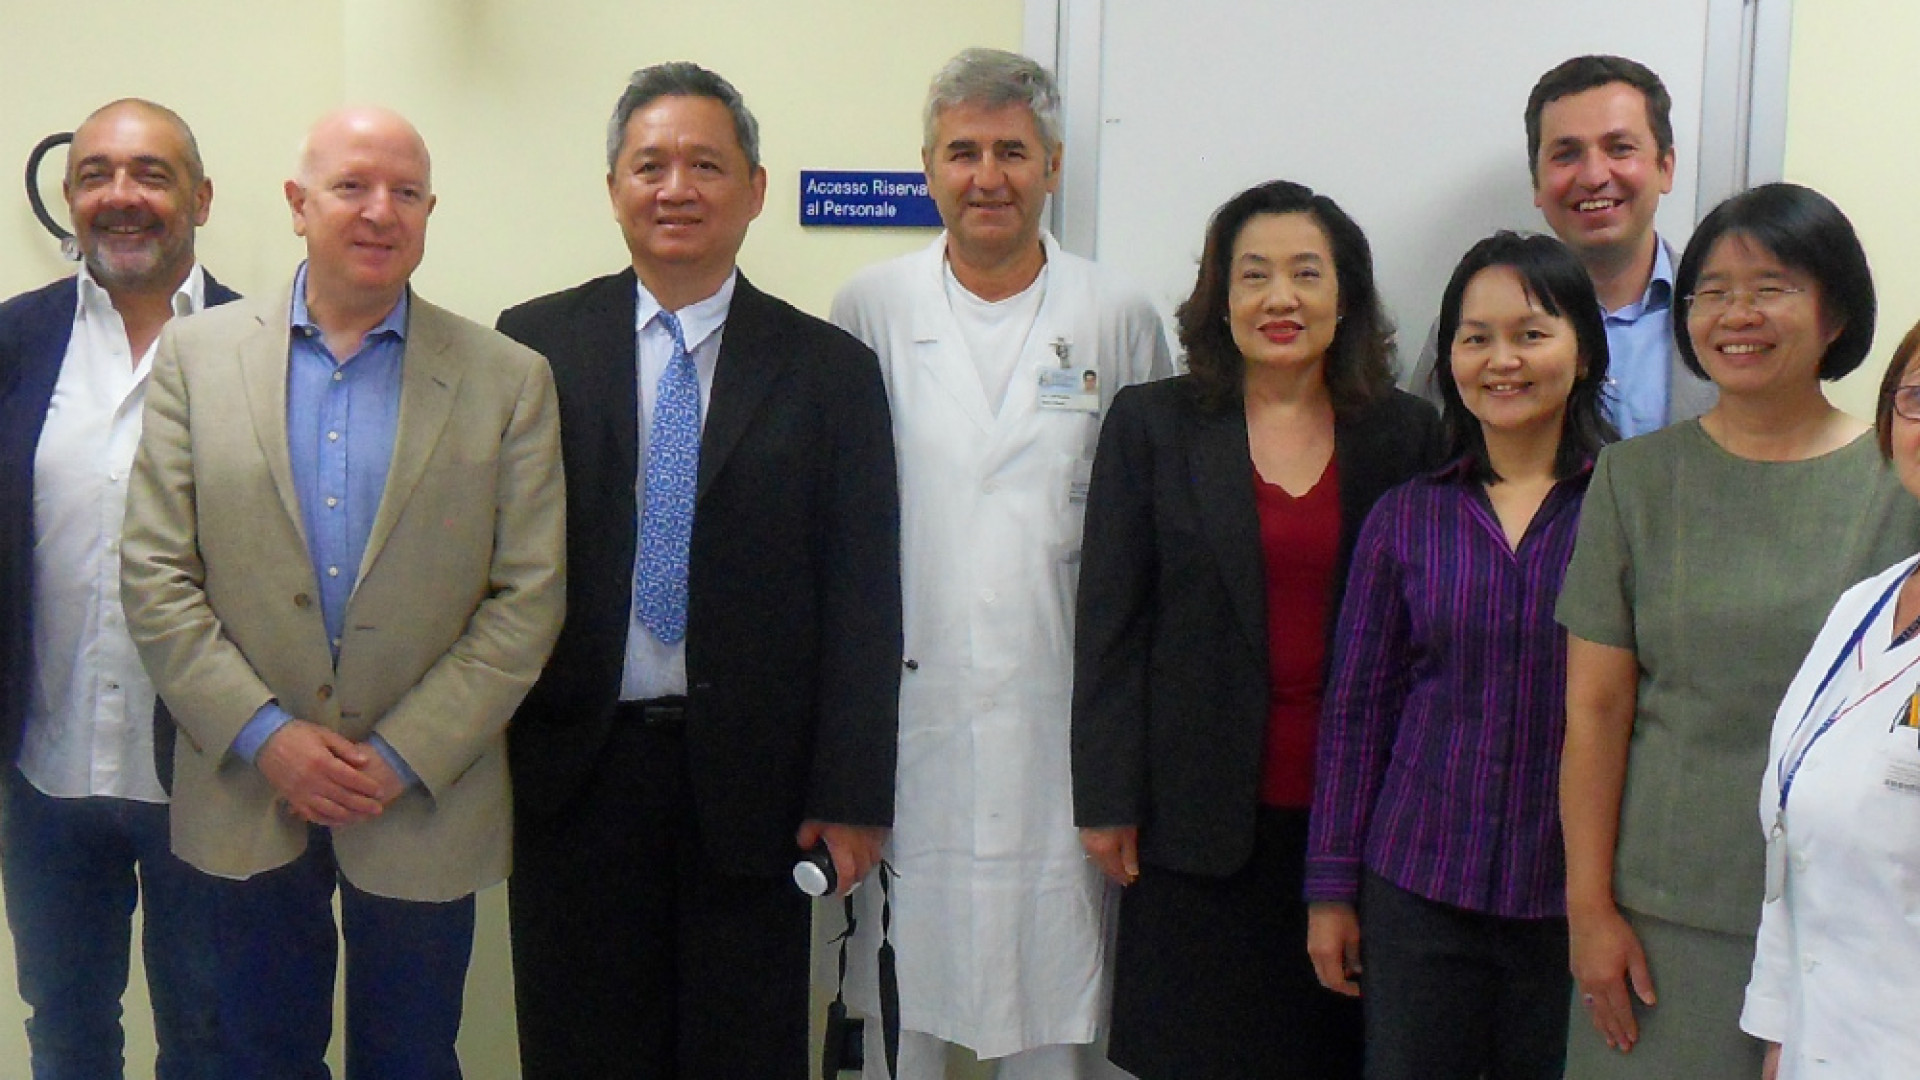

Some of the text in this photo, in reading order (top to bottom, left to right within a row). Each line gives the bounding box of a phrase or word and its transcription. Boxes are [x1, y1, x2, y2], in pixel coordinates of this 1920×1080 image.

[806, 178, 868, 195] Accesso
[806, 200, 897, 217] al Personale
